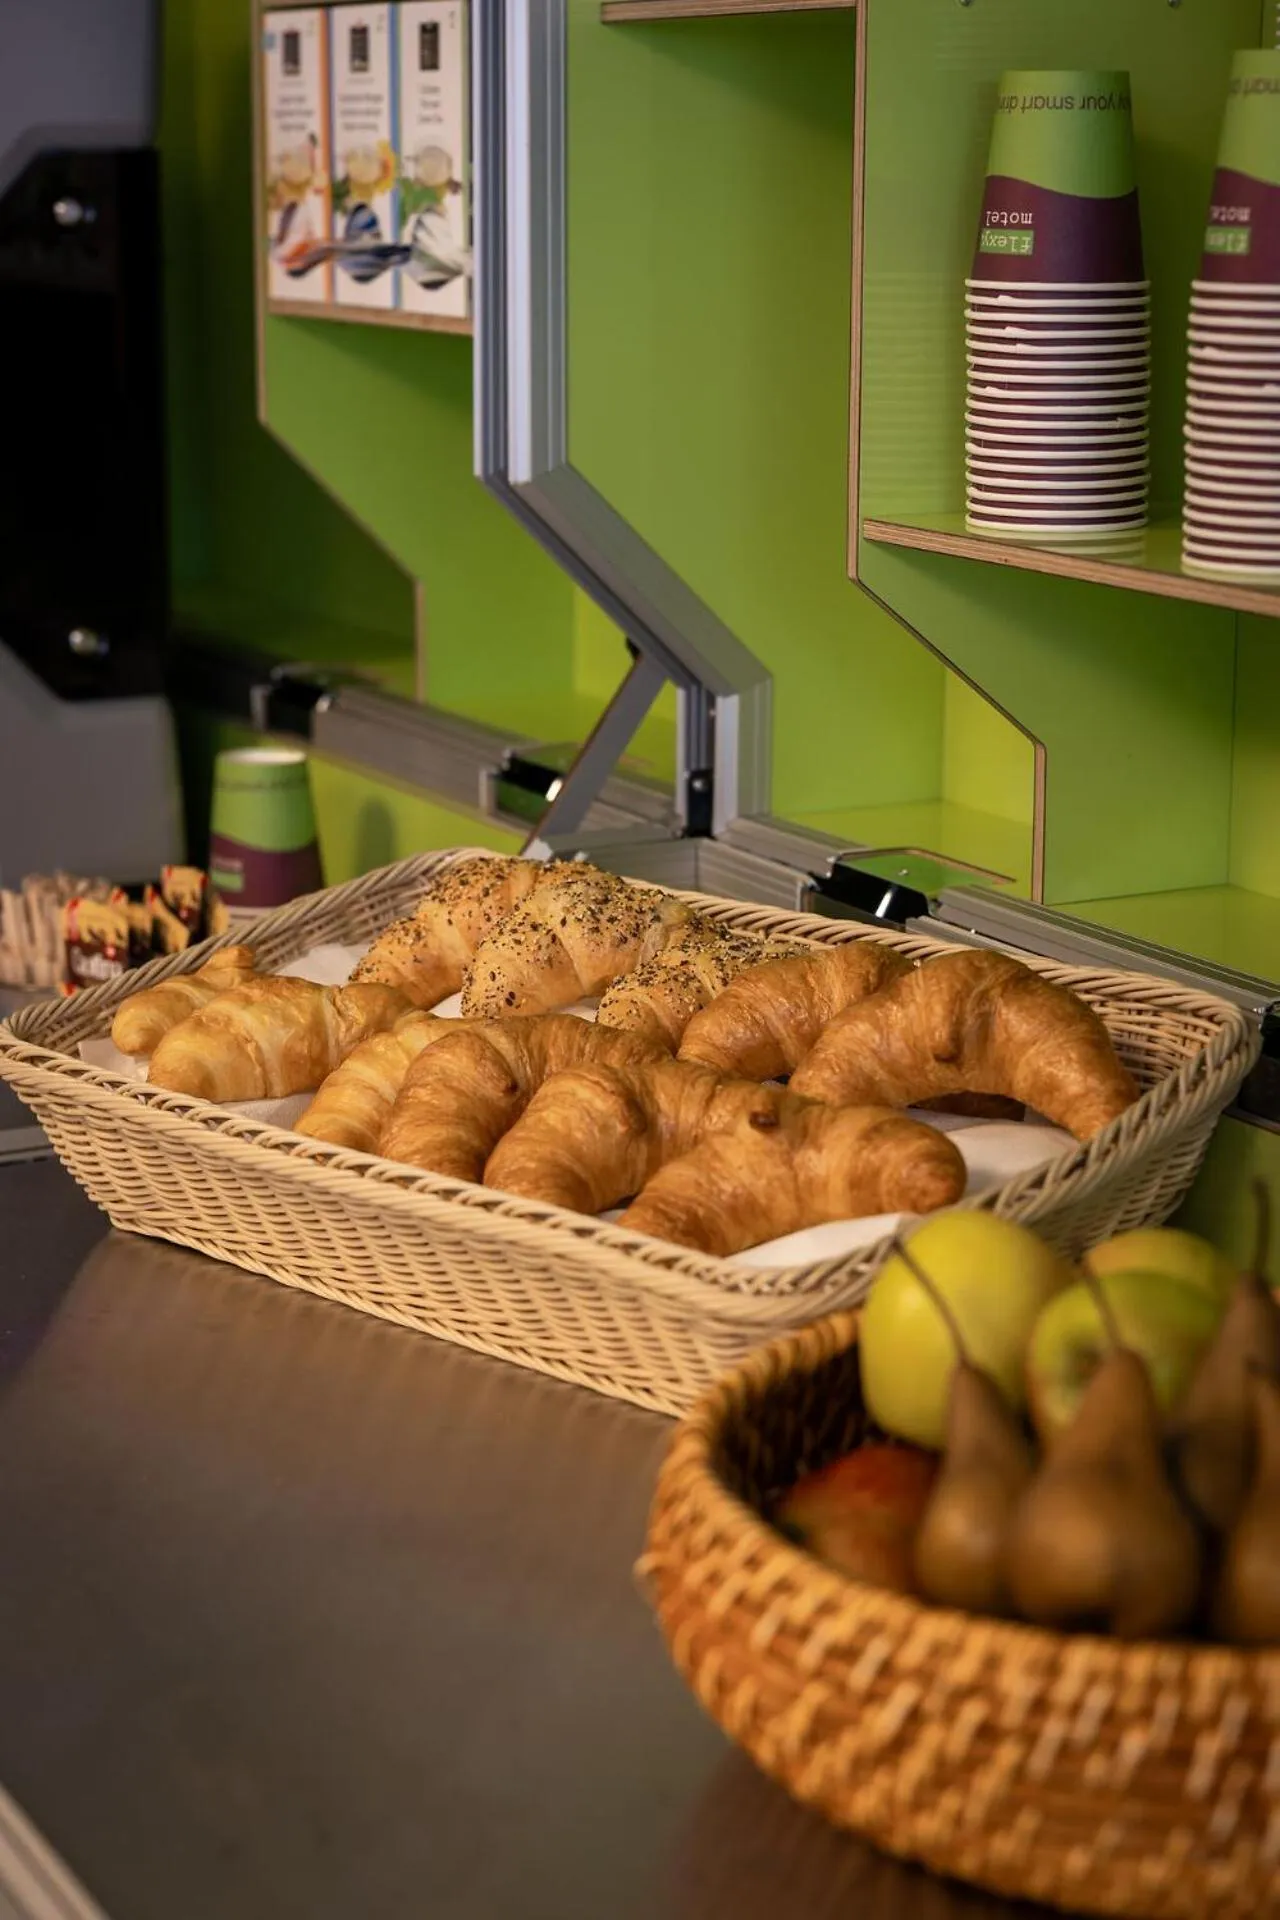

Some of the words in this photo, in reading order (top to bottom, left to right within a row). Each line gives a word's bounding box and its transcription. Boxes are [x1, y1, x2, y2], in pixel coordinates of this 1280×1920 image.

[1020, 95, 1075, 114] smart
[1080, 93, 1117, 112] your
[986, 211, 1033, 227] motel
